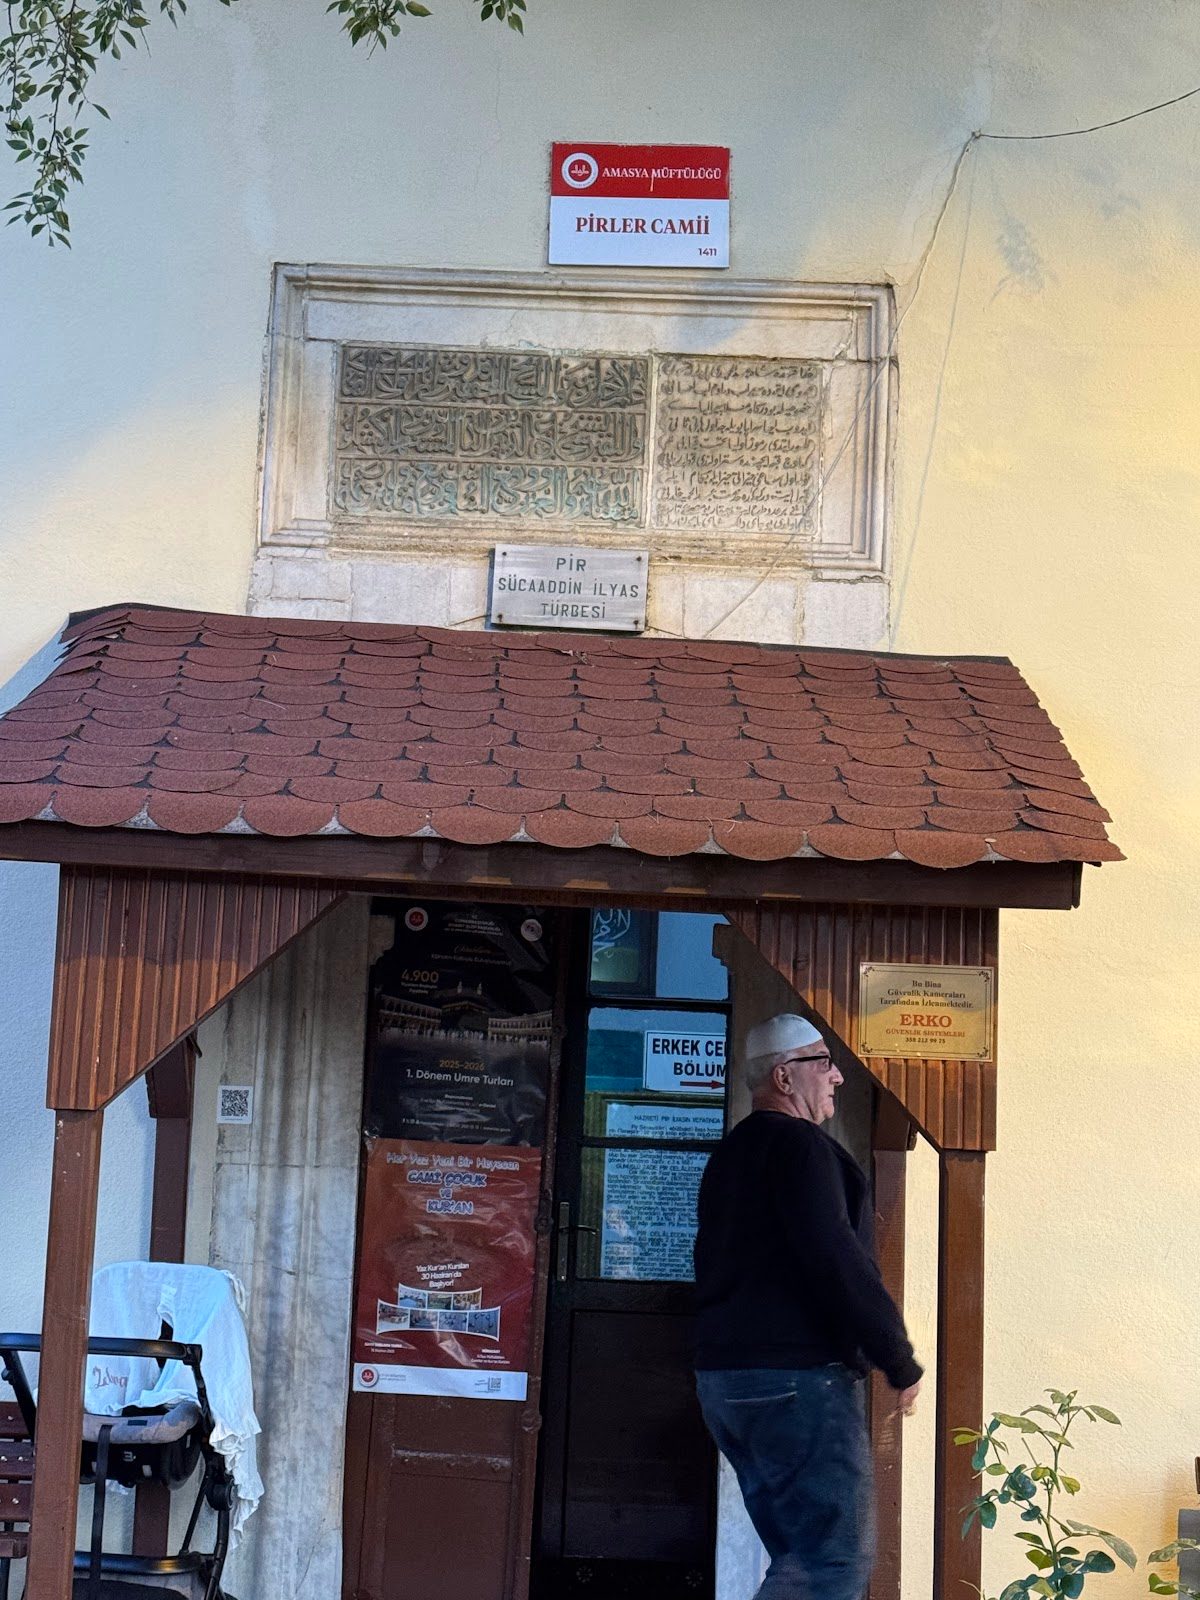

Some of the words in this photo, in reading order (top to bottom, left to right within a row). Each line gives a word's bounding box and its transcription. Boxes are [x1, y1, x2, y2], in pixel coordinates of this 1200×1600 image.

[602, 167, 649, 178] AMASYA
[651, 166, 721, 180] MÜFTÜLÜĞÜ
[576, 213, 647, 233] PİRLER
[651, 215, 709, 235] CAMİİ
[698, 247, 717, 256] 1411
[556, 553, 586, 572] PİR
[498, 574, 582, 594] SÜCAADDİN
[593, 578, 639, 598] İLYAS
[541, 600, 606, 619] TÜRBESİ
[401, 969, 439, 983] 4.900
[912, 980, 922, 988] Bu
[924, 980, 942, 988] Bina
[887, 988, 920, 997] Güvenlik
[923, 990, 966, 999] Kameraları
[879, 998, 920, 1006] Tarafından
[900, 1013, 952, 1028] ERKO
[885, 1028, 921, 1036] GÜVENLİK
[652, 1038, 701, 1056] ERKEK
[439, 1059, 486, 1071] 2025-2026
[406, 1068, 414, 1078] 1.
[416, 1069, 451, 1081] Dönem
[454, 1074, 480, 1084] Umre
[483, 1075, 514, 1087] Turları
[432, 1154, 454, 1167] Yeni
[457, 1155, 474, 1168] Bir
[408, 1169, 441, 1184] CAMİ
[444, 1172, 487, 1187] ÇOCUK
[426, 1200, 474, 1215] KUR'AN
